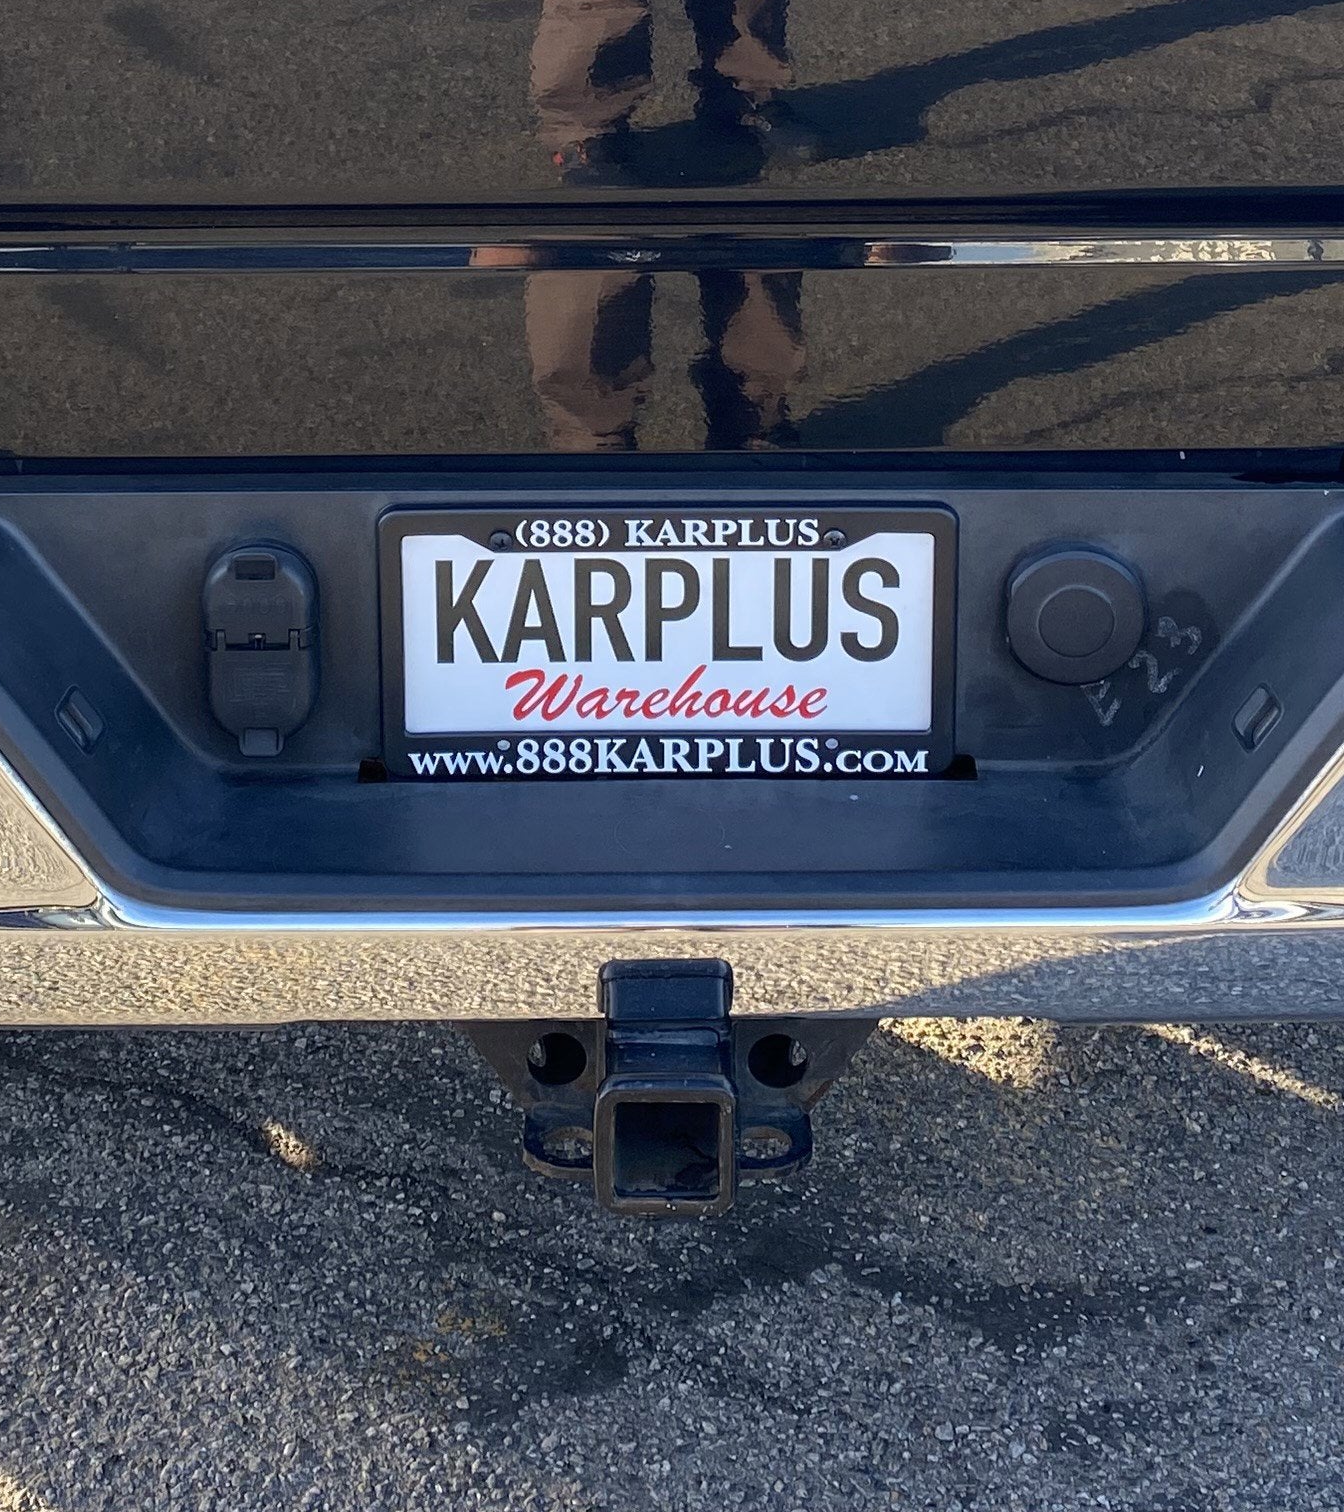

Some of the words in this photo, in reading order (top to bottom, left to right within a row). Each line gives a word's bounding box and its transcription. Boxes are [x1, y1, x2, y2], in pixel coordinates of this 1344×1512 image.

[515, 518, 609, 548] (888)
[624, 518, 820, 548] KARPLUS
[433, 556, 901, 664] KARPLUS
[504, 664, 828, 723] Warehouse
